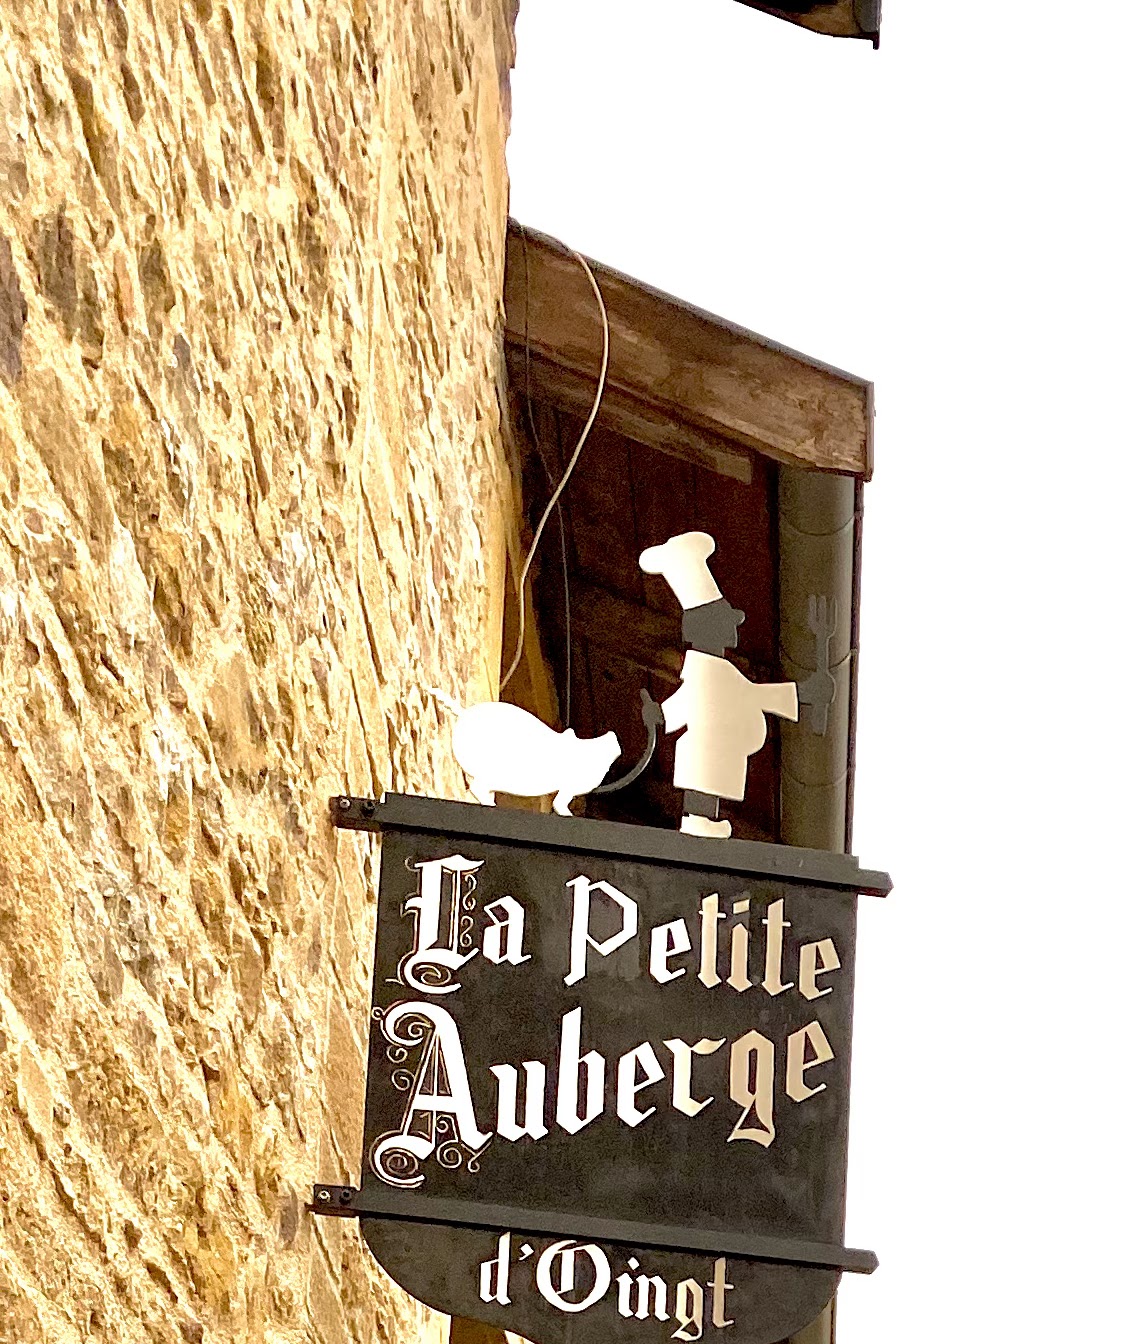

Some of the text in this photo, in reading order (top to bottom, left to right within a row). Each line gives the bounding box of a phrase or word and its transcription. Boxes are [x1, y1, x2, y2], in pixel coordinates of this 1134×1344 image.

[388, 854, 842, 1000] La Petite
[370, 1000, 836, 1187] Auberge
[478, 1232, 734, 1341] d'Oingt
